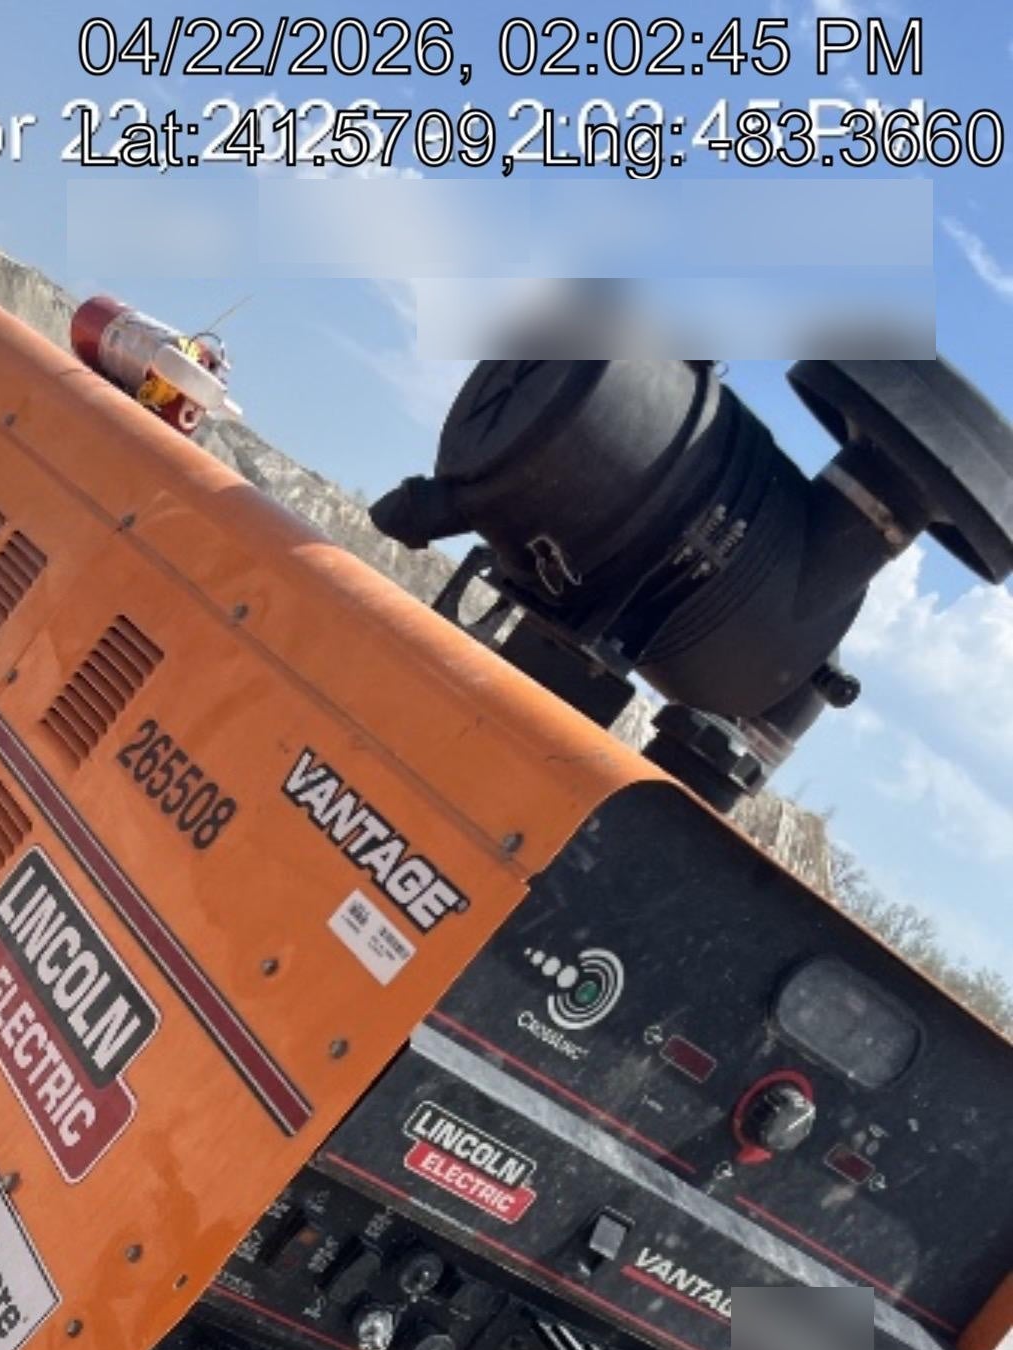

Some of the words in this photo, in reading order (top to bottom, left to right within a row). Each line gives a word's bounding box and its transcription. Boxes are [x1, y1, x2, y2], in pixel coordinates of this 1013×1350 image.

[116, 719, 237, 851] 265508
[283, 747, 464, 934] VANTAGE
[413, 1110, 525, 1186] LINCOLN
[420, 1151, 515, 1213] ELECTRIC
